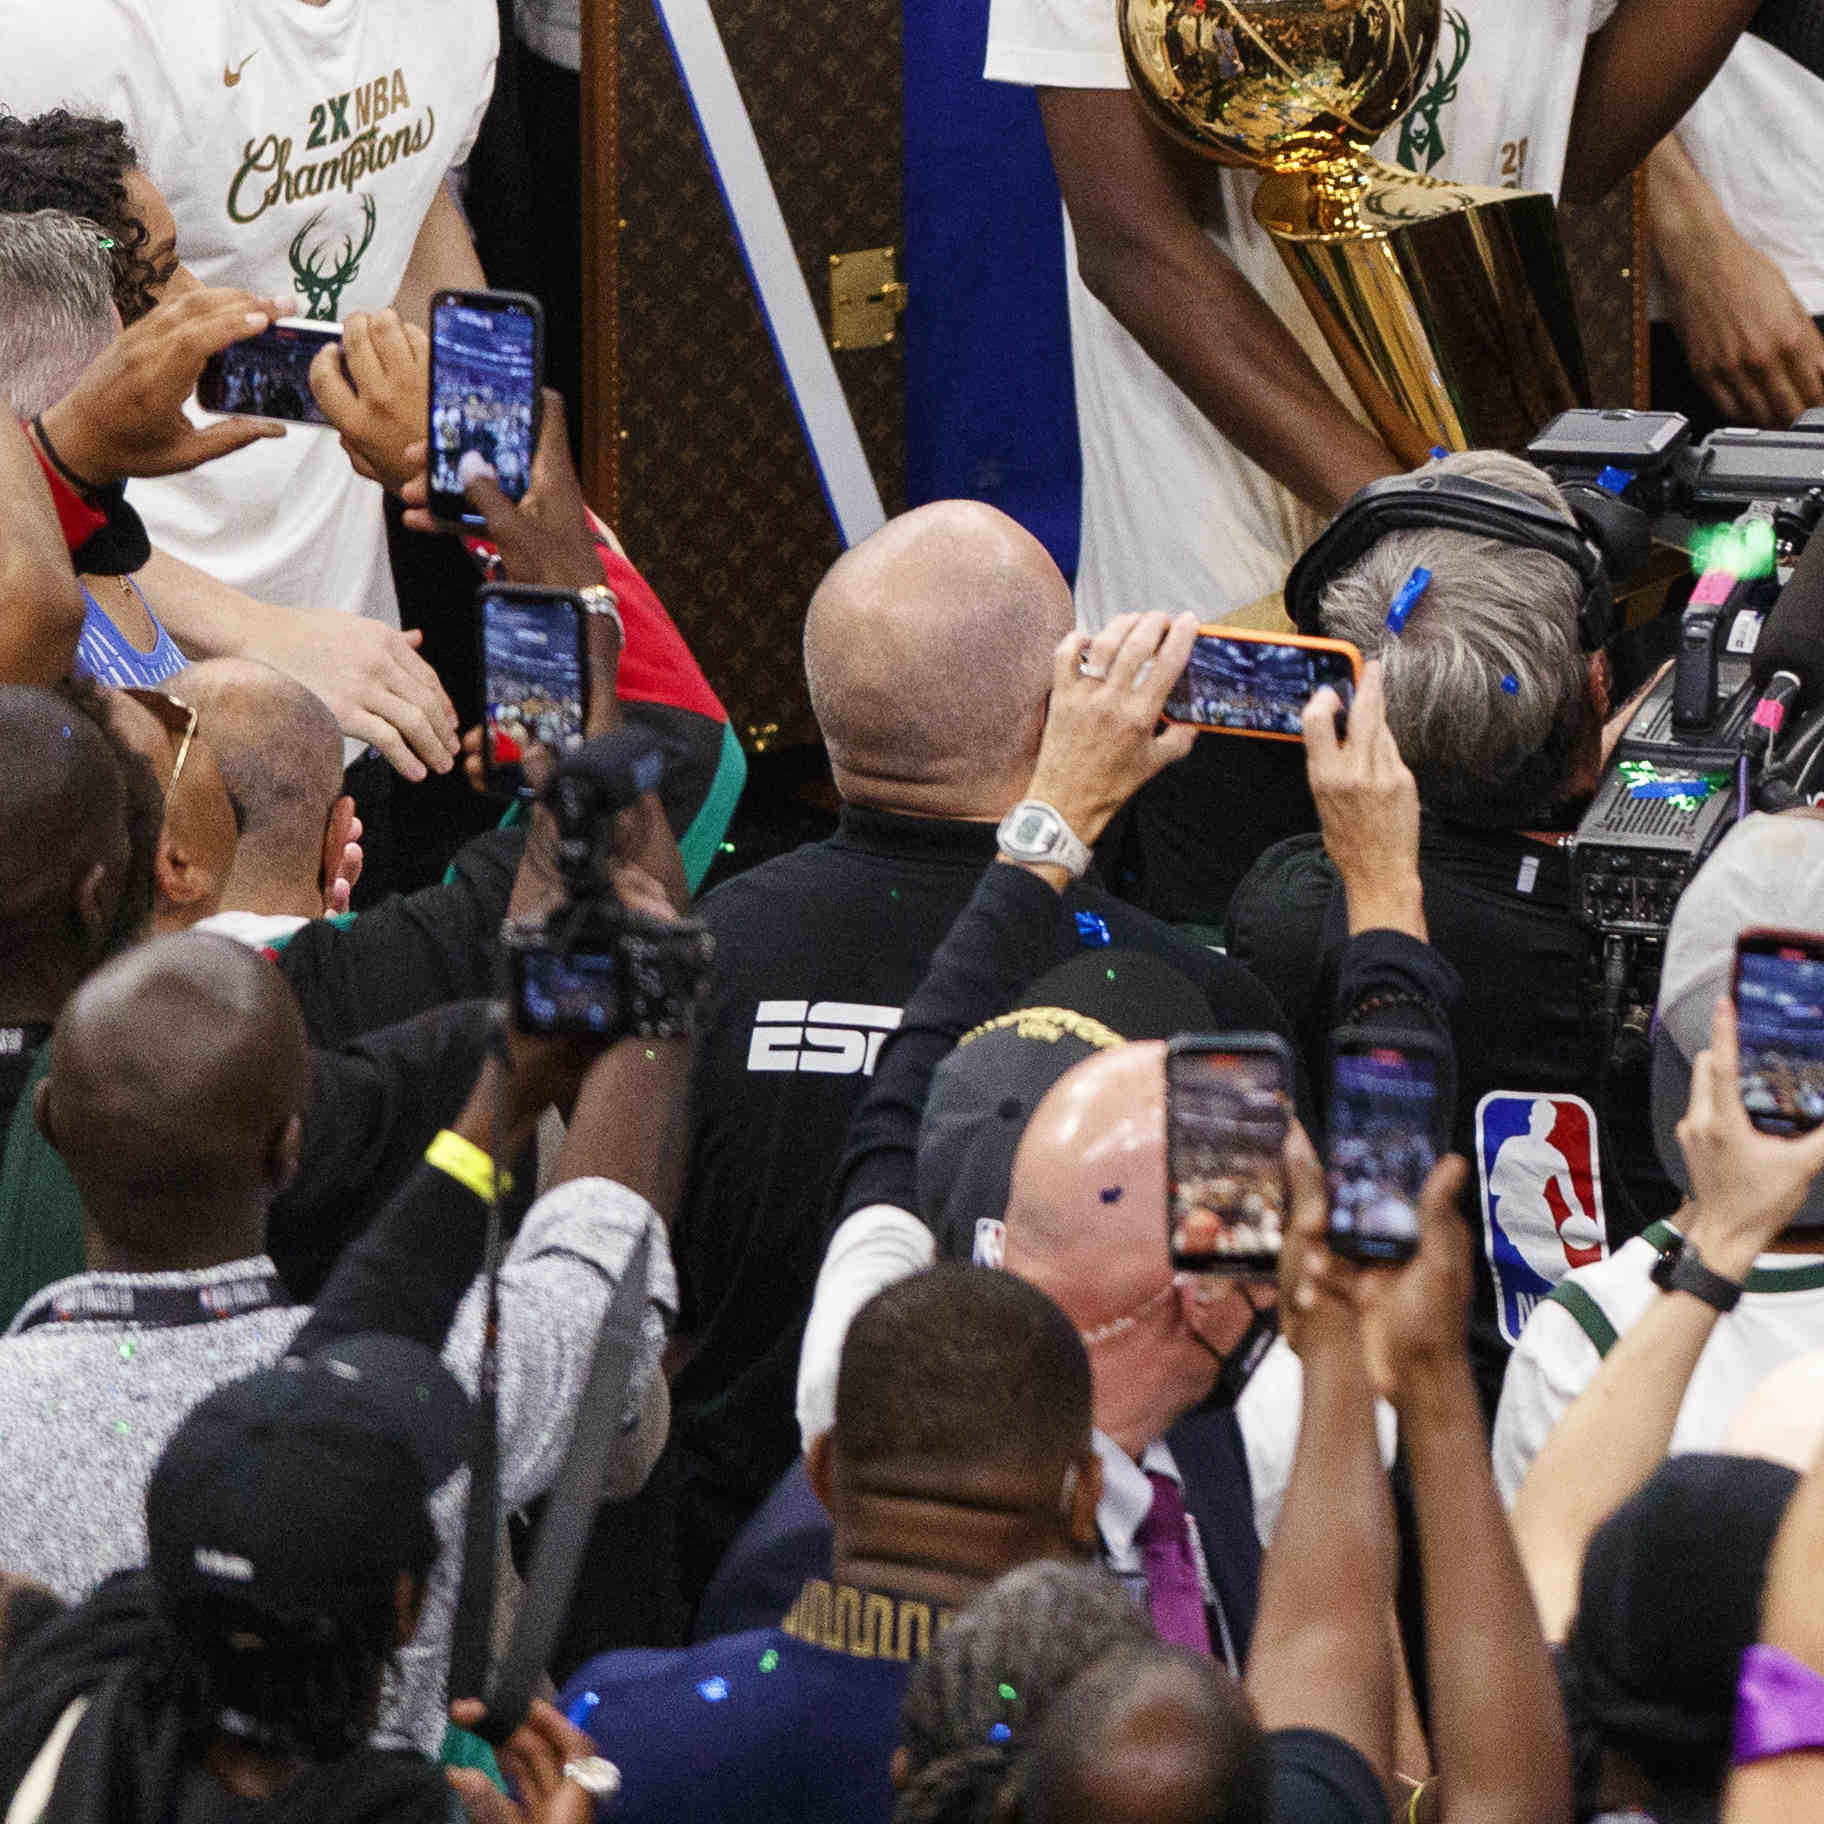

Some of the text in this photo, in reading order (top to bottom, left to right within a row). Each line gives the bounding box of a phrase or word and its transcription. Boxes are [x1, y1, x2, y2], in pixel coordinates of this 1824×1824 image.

[304, 67, 411, 153] 2X NBA
[226, 105, 435, 225] Champions
